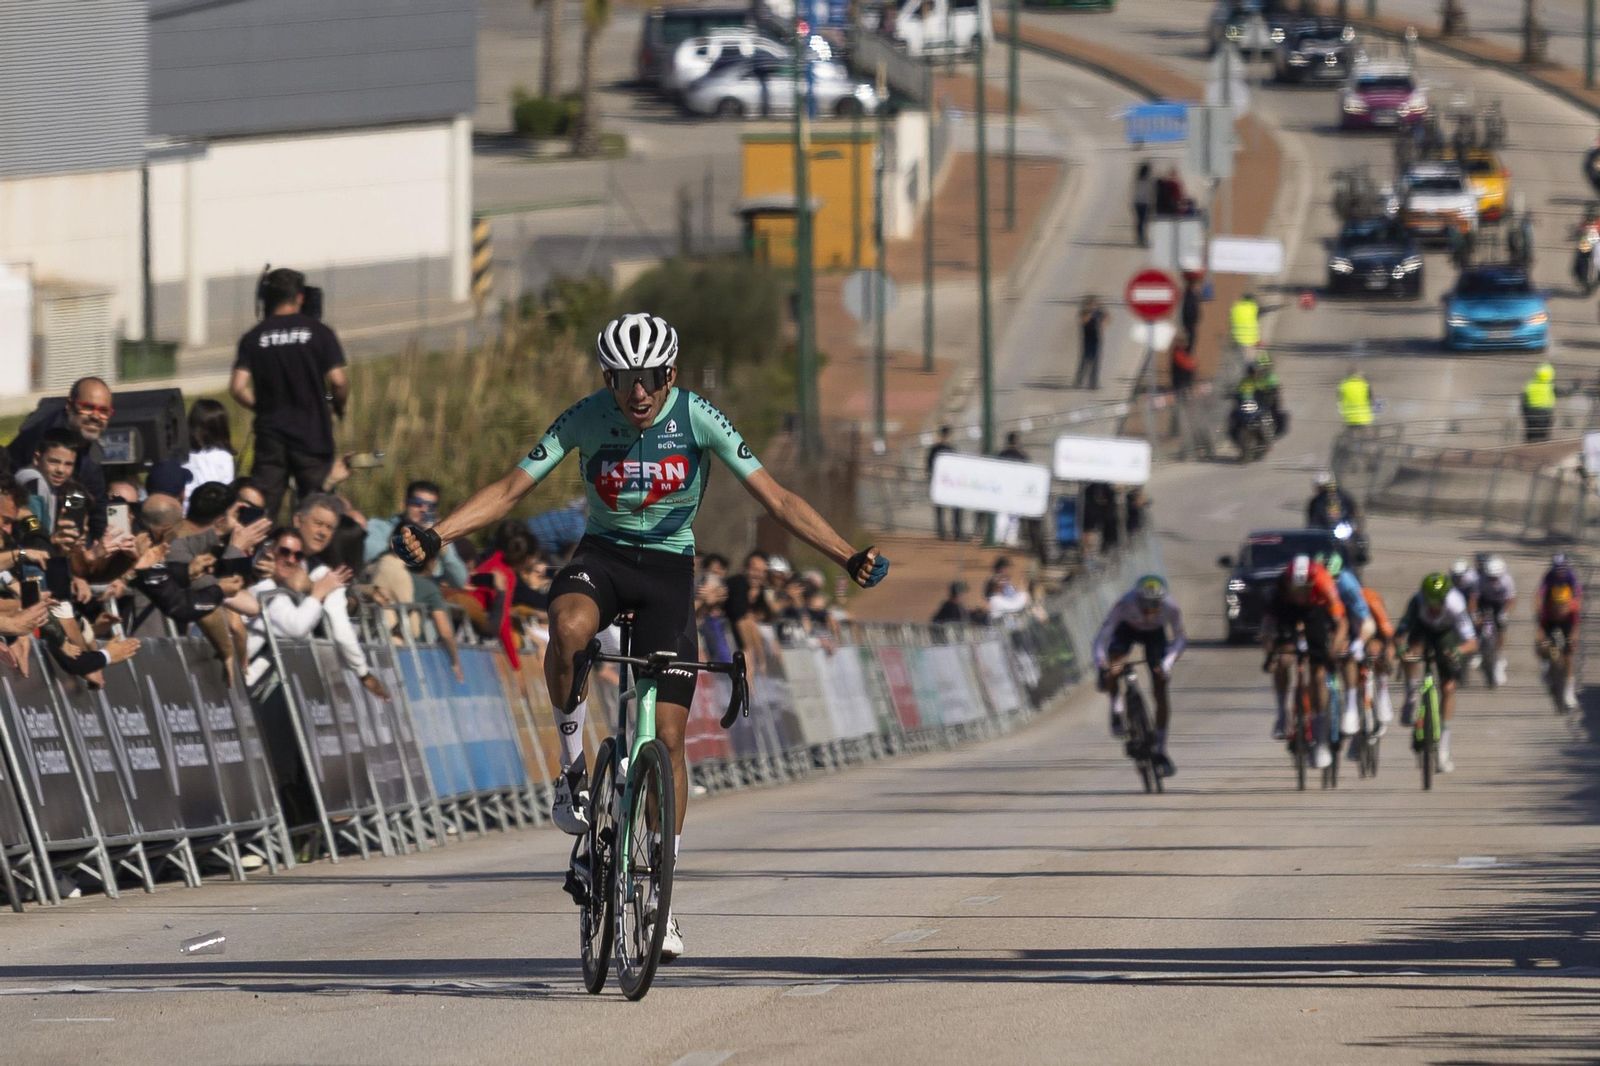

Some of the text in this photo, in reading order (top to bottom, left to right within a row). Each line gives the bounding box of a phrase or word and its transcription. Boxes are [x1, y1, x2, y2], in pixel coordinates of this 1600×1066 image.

[259, 329, 312, 348] STAFF
[601, 461, 686, 480] KERN
[601, 479, 686, 491] PHARMA
[662, 668, 694, 678] IANT
